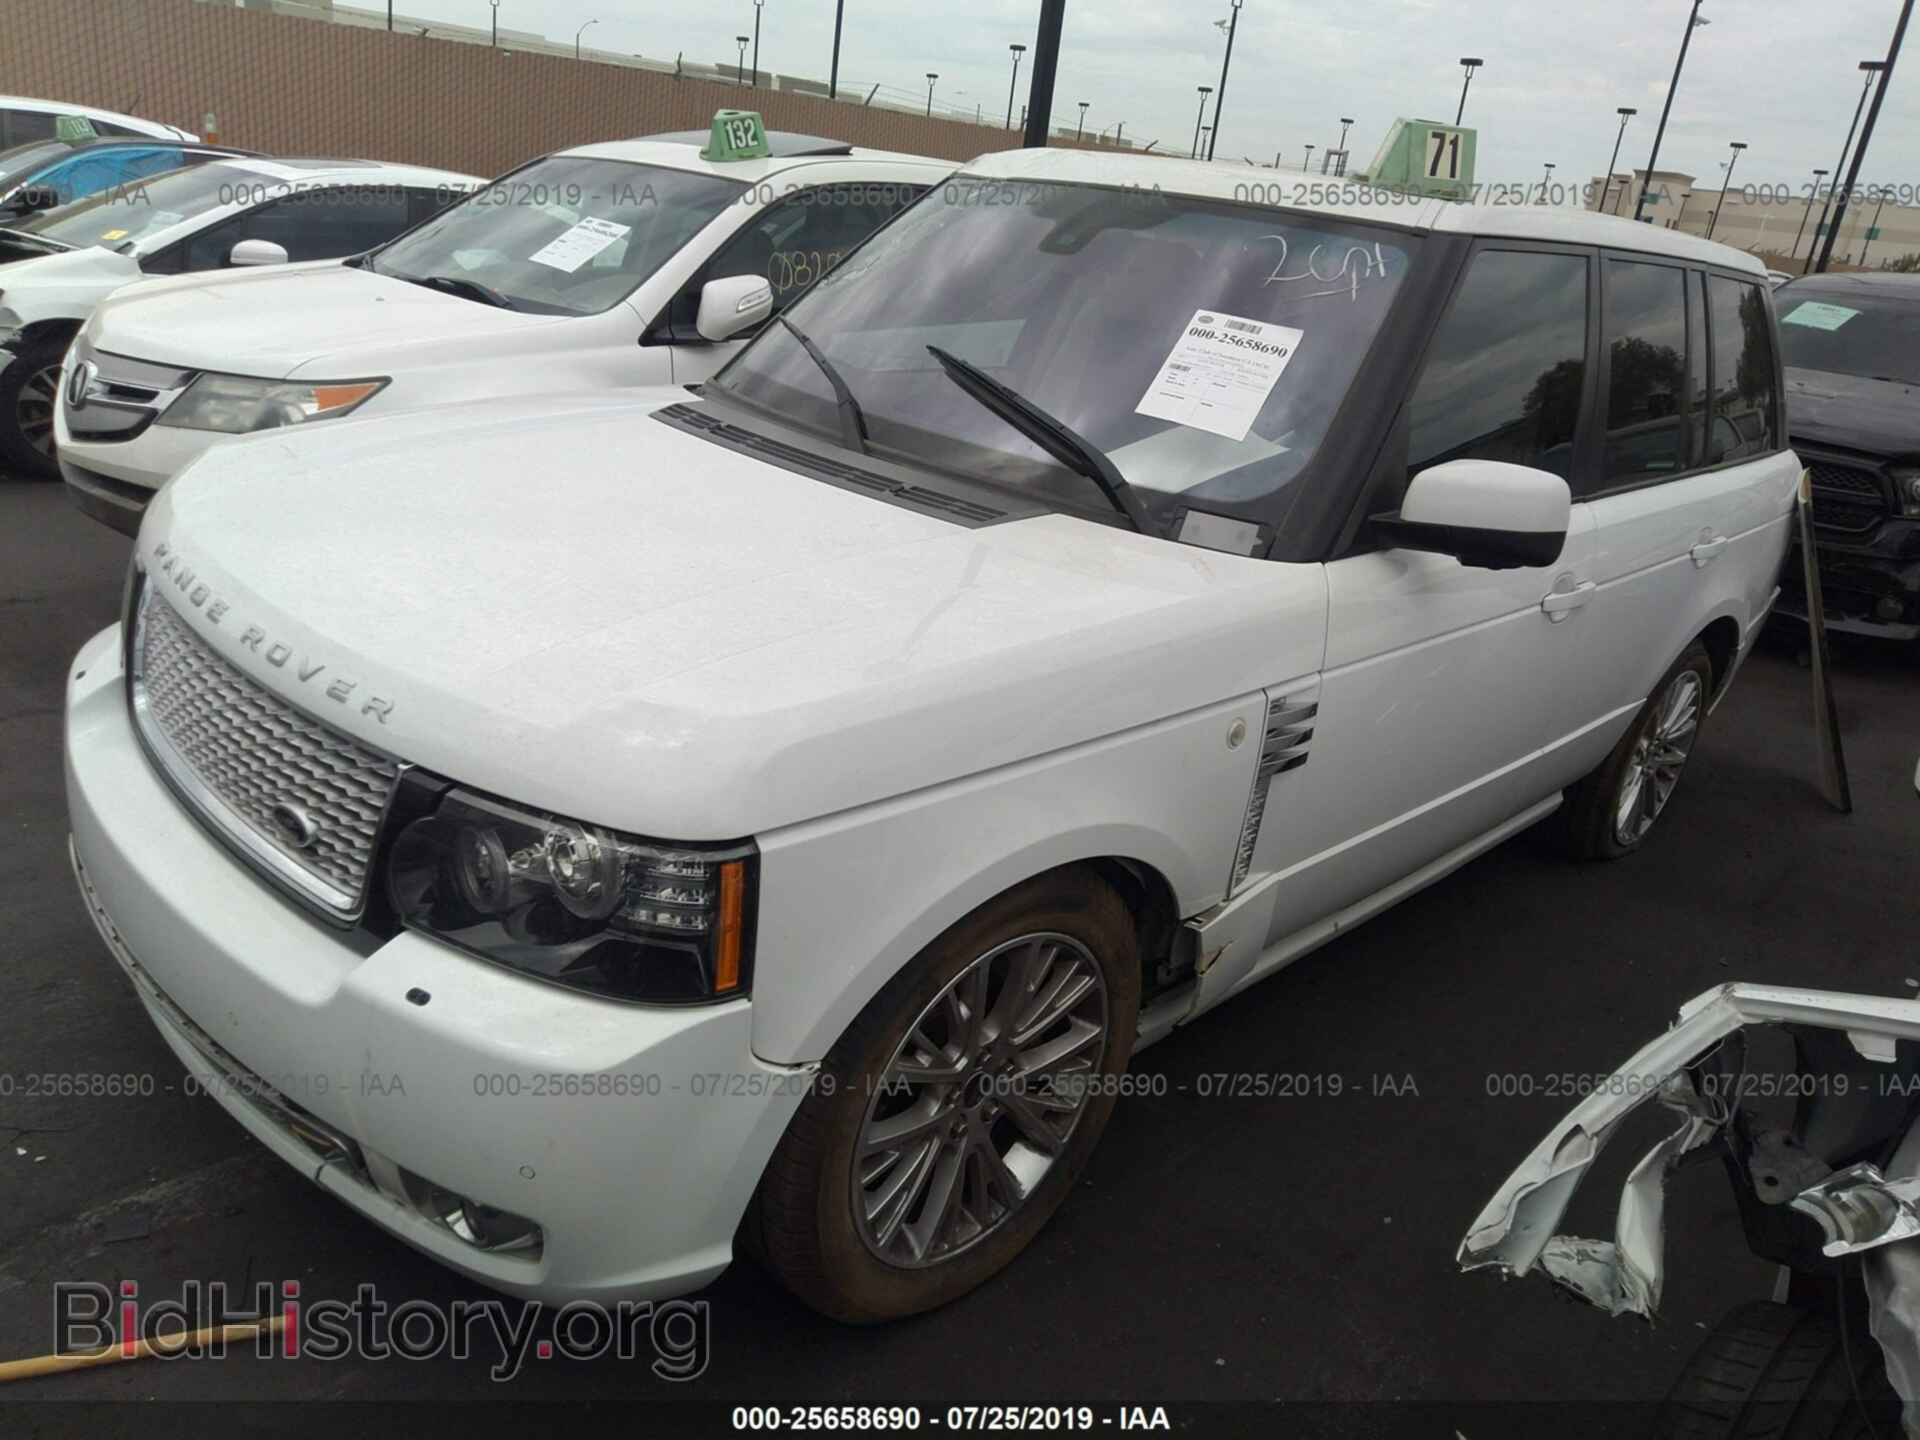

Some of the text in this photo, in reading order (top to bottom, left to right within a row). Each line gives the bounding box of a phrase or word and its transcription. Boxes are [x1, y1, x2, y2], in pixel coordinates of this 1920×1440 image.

[725, 118, 759, 150] 132
[1429, 131, 1459, 179] 71
[1188, 326, 1289, 359] 000-25658690
[153, 543, 395, 725] RANGE ROVER
